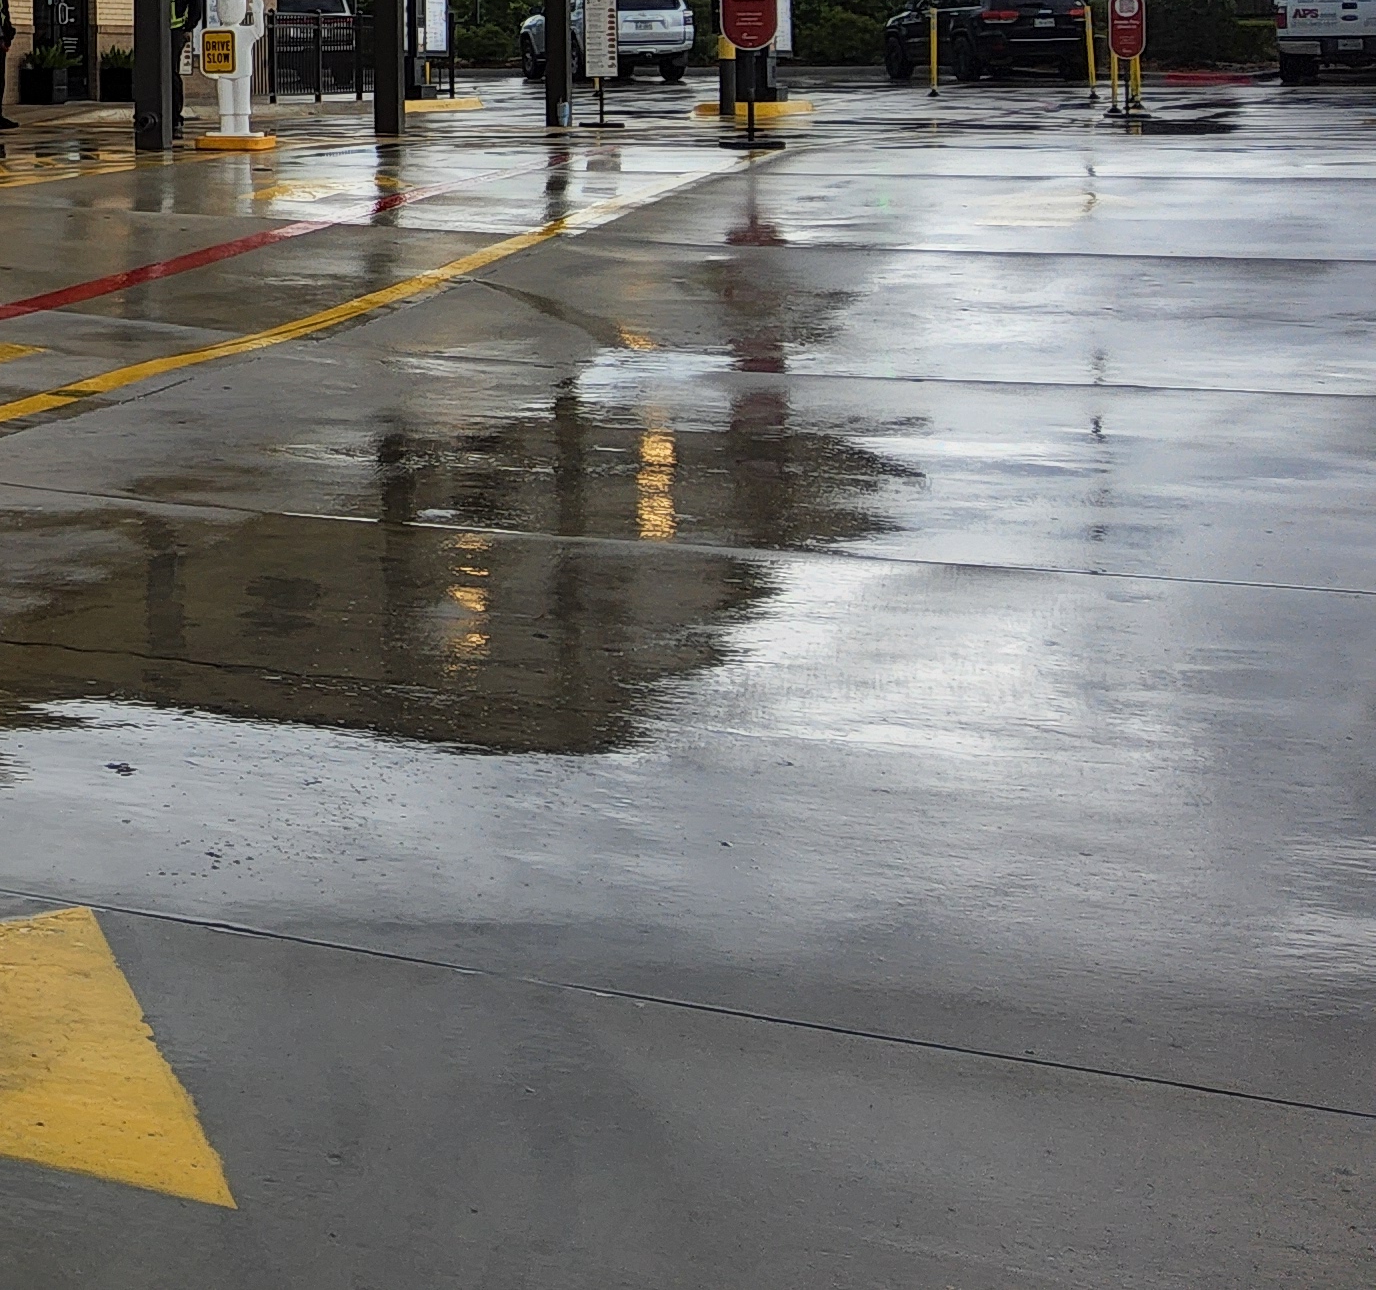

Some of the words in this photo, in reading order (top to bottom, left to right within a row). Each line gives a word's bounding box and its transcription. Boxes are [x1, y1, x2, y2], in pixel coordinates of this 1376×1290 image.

[1292, 8, 1319, 19] APS
[205, 40, 231, 52] DRIVE
[206, 53, 230, 64] SLOW
